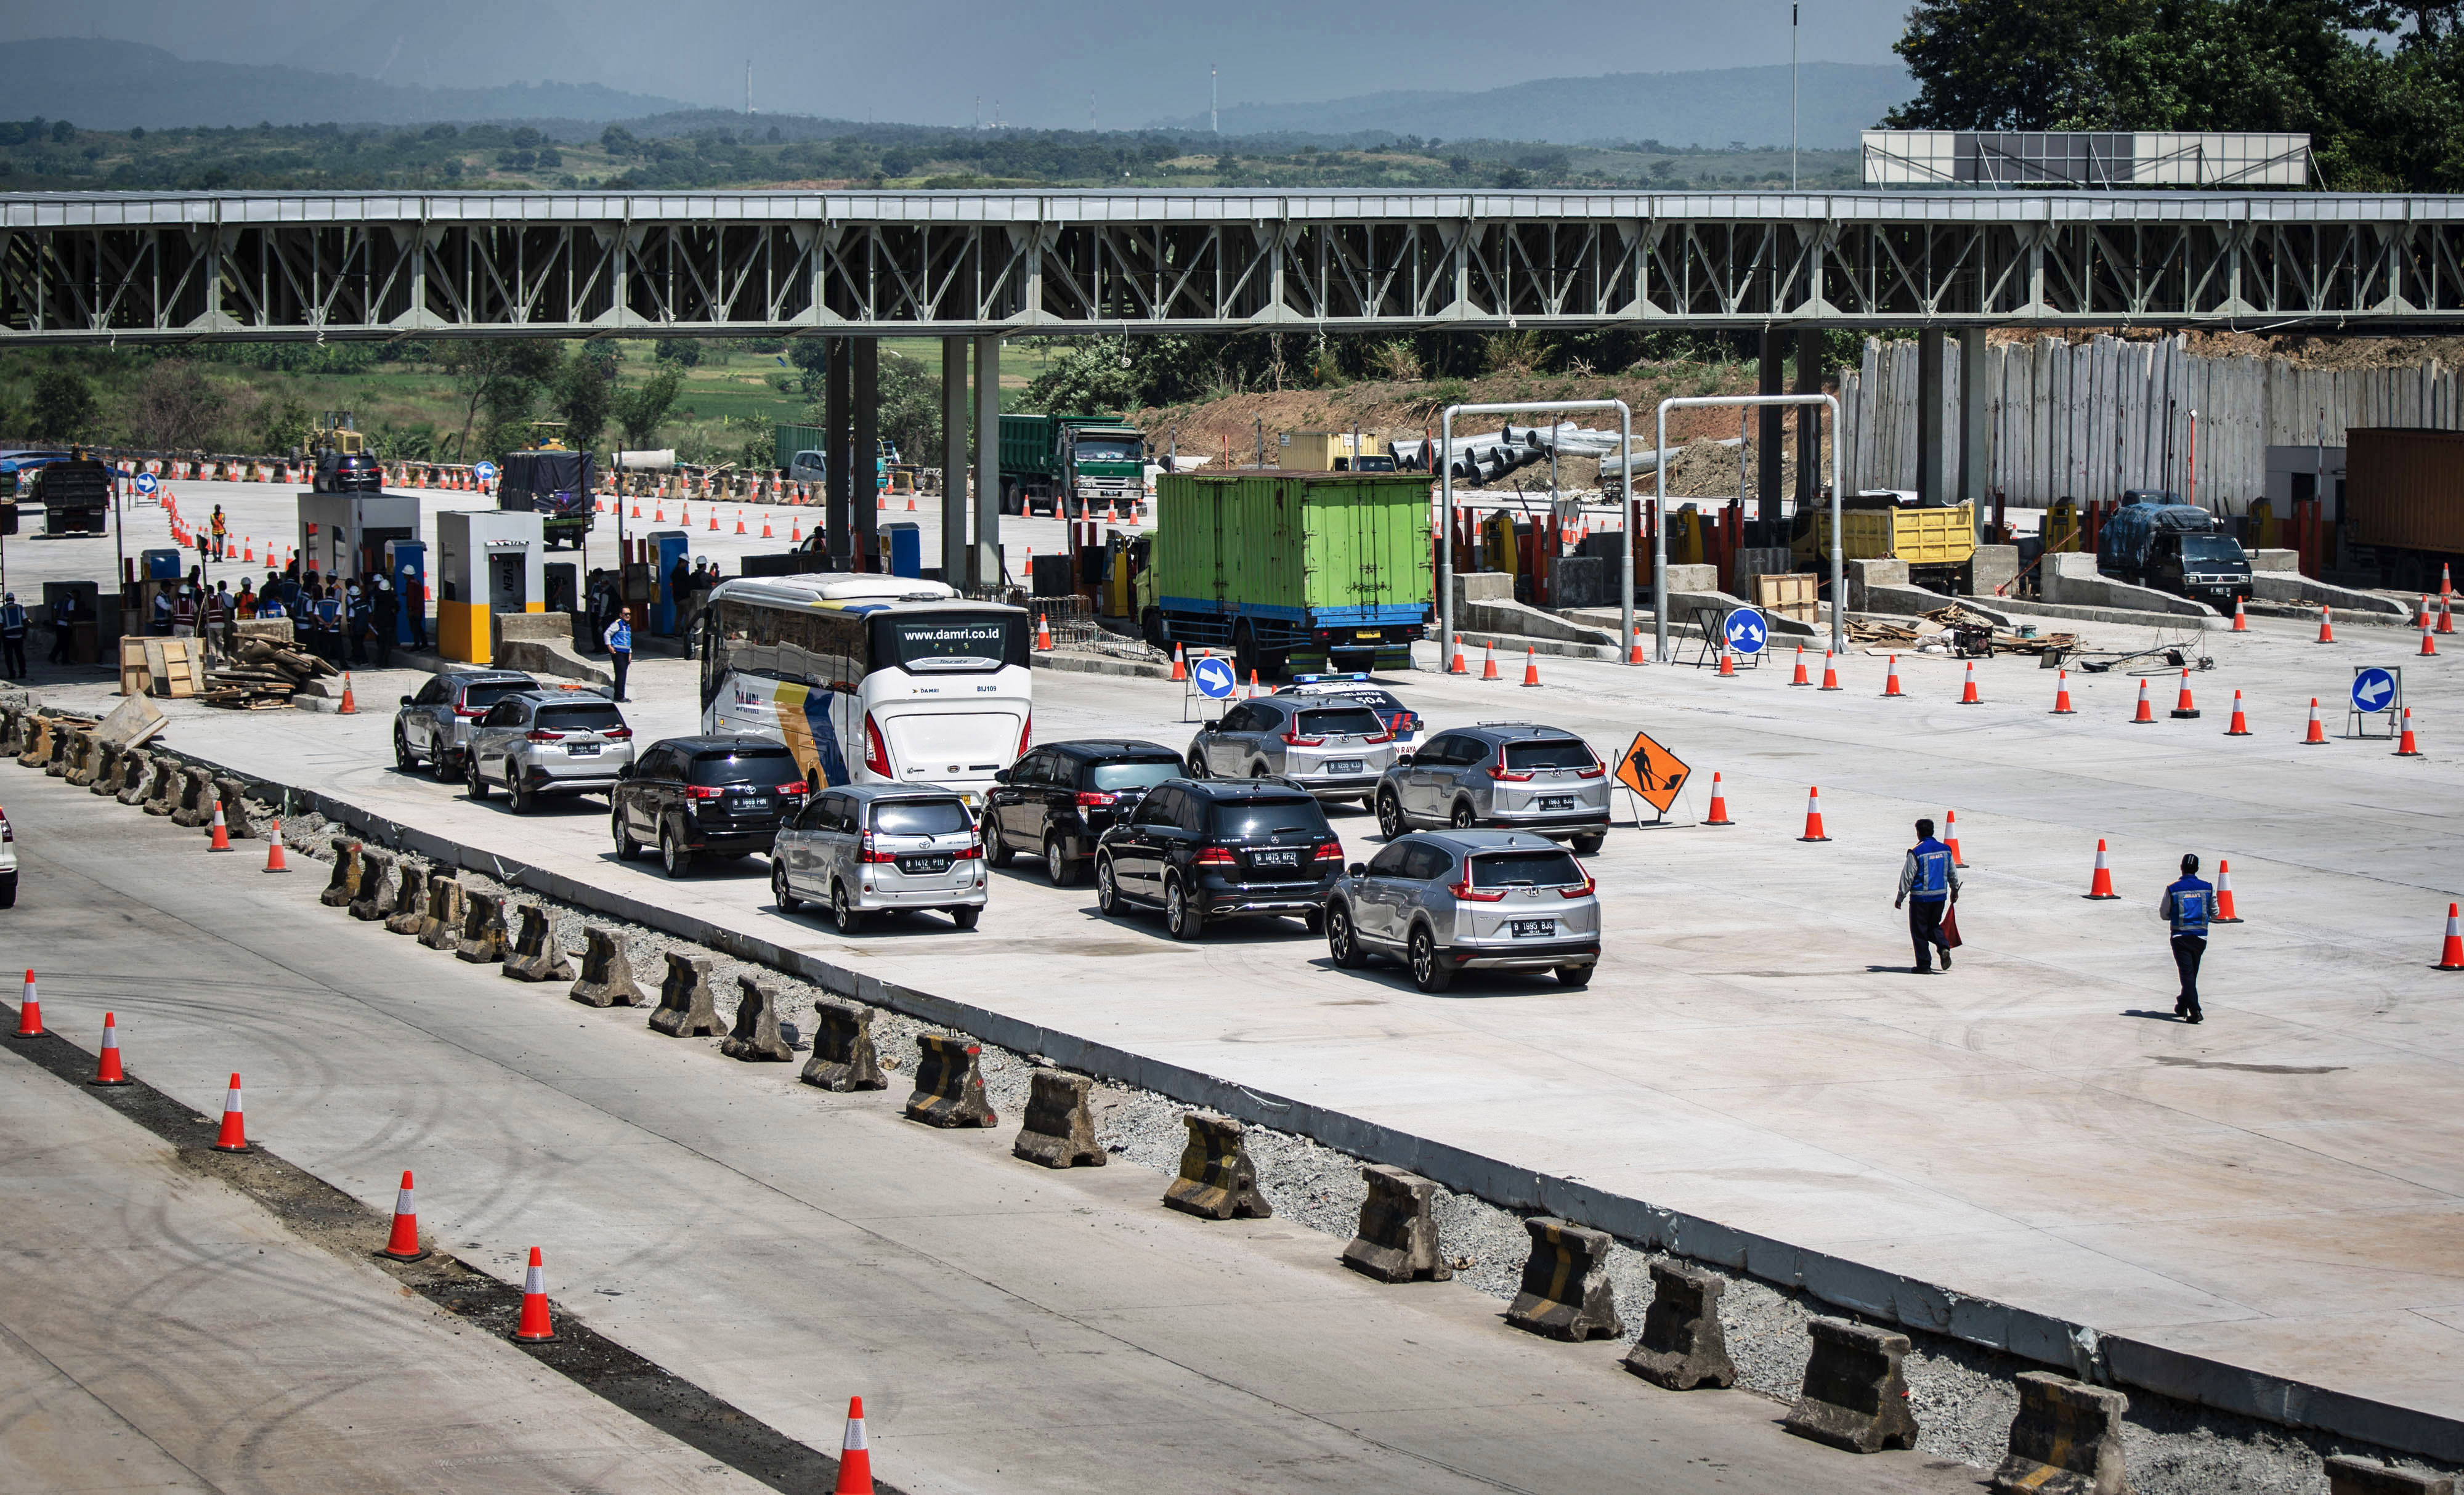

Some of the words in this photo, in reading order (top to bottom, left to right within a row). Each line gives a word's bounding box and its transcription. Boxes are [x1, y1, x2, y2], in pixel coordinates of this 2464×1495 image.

[904, 628, 999, 641] www.damri.co.id
[1401, 746, 1416, 754] RAYA
[1257, 853, 1262, 861] B
[1265, 853, 1279, 861] 1875
[1514, 923, 1519, 931] B
[1523, 922, 1538, 930] 1995
[1541, 921, 1553, 930] BJS
